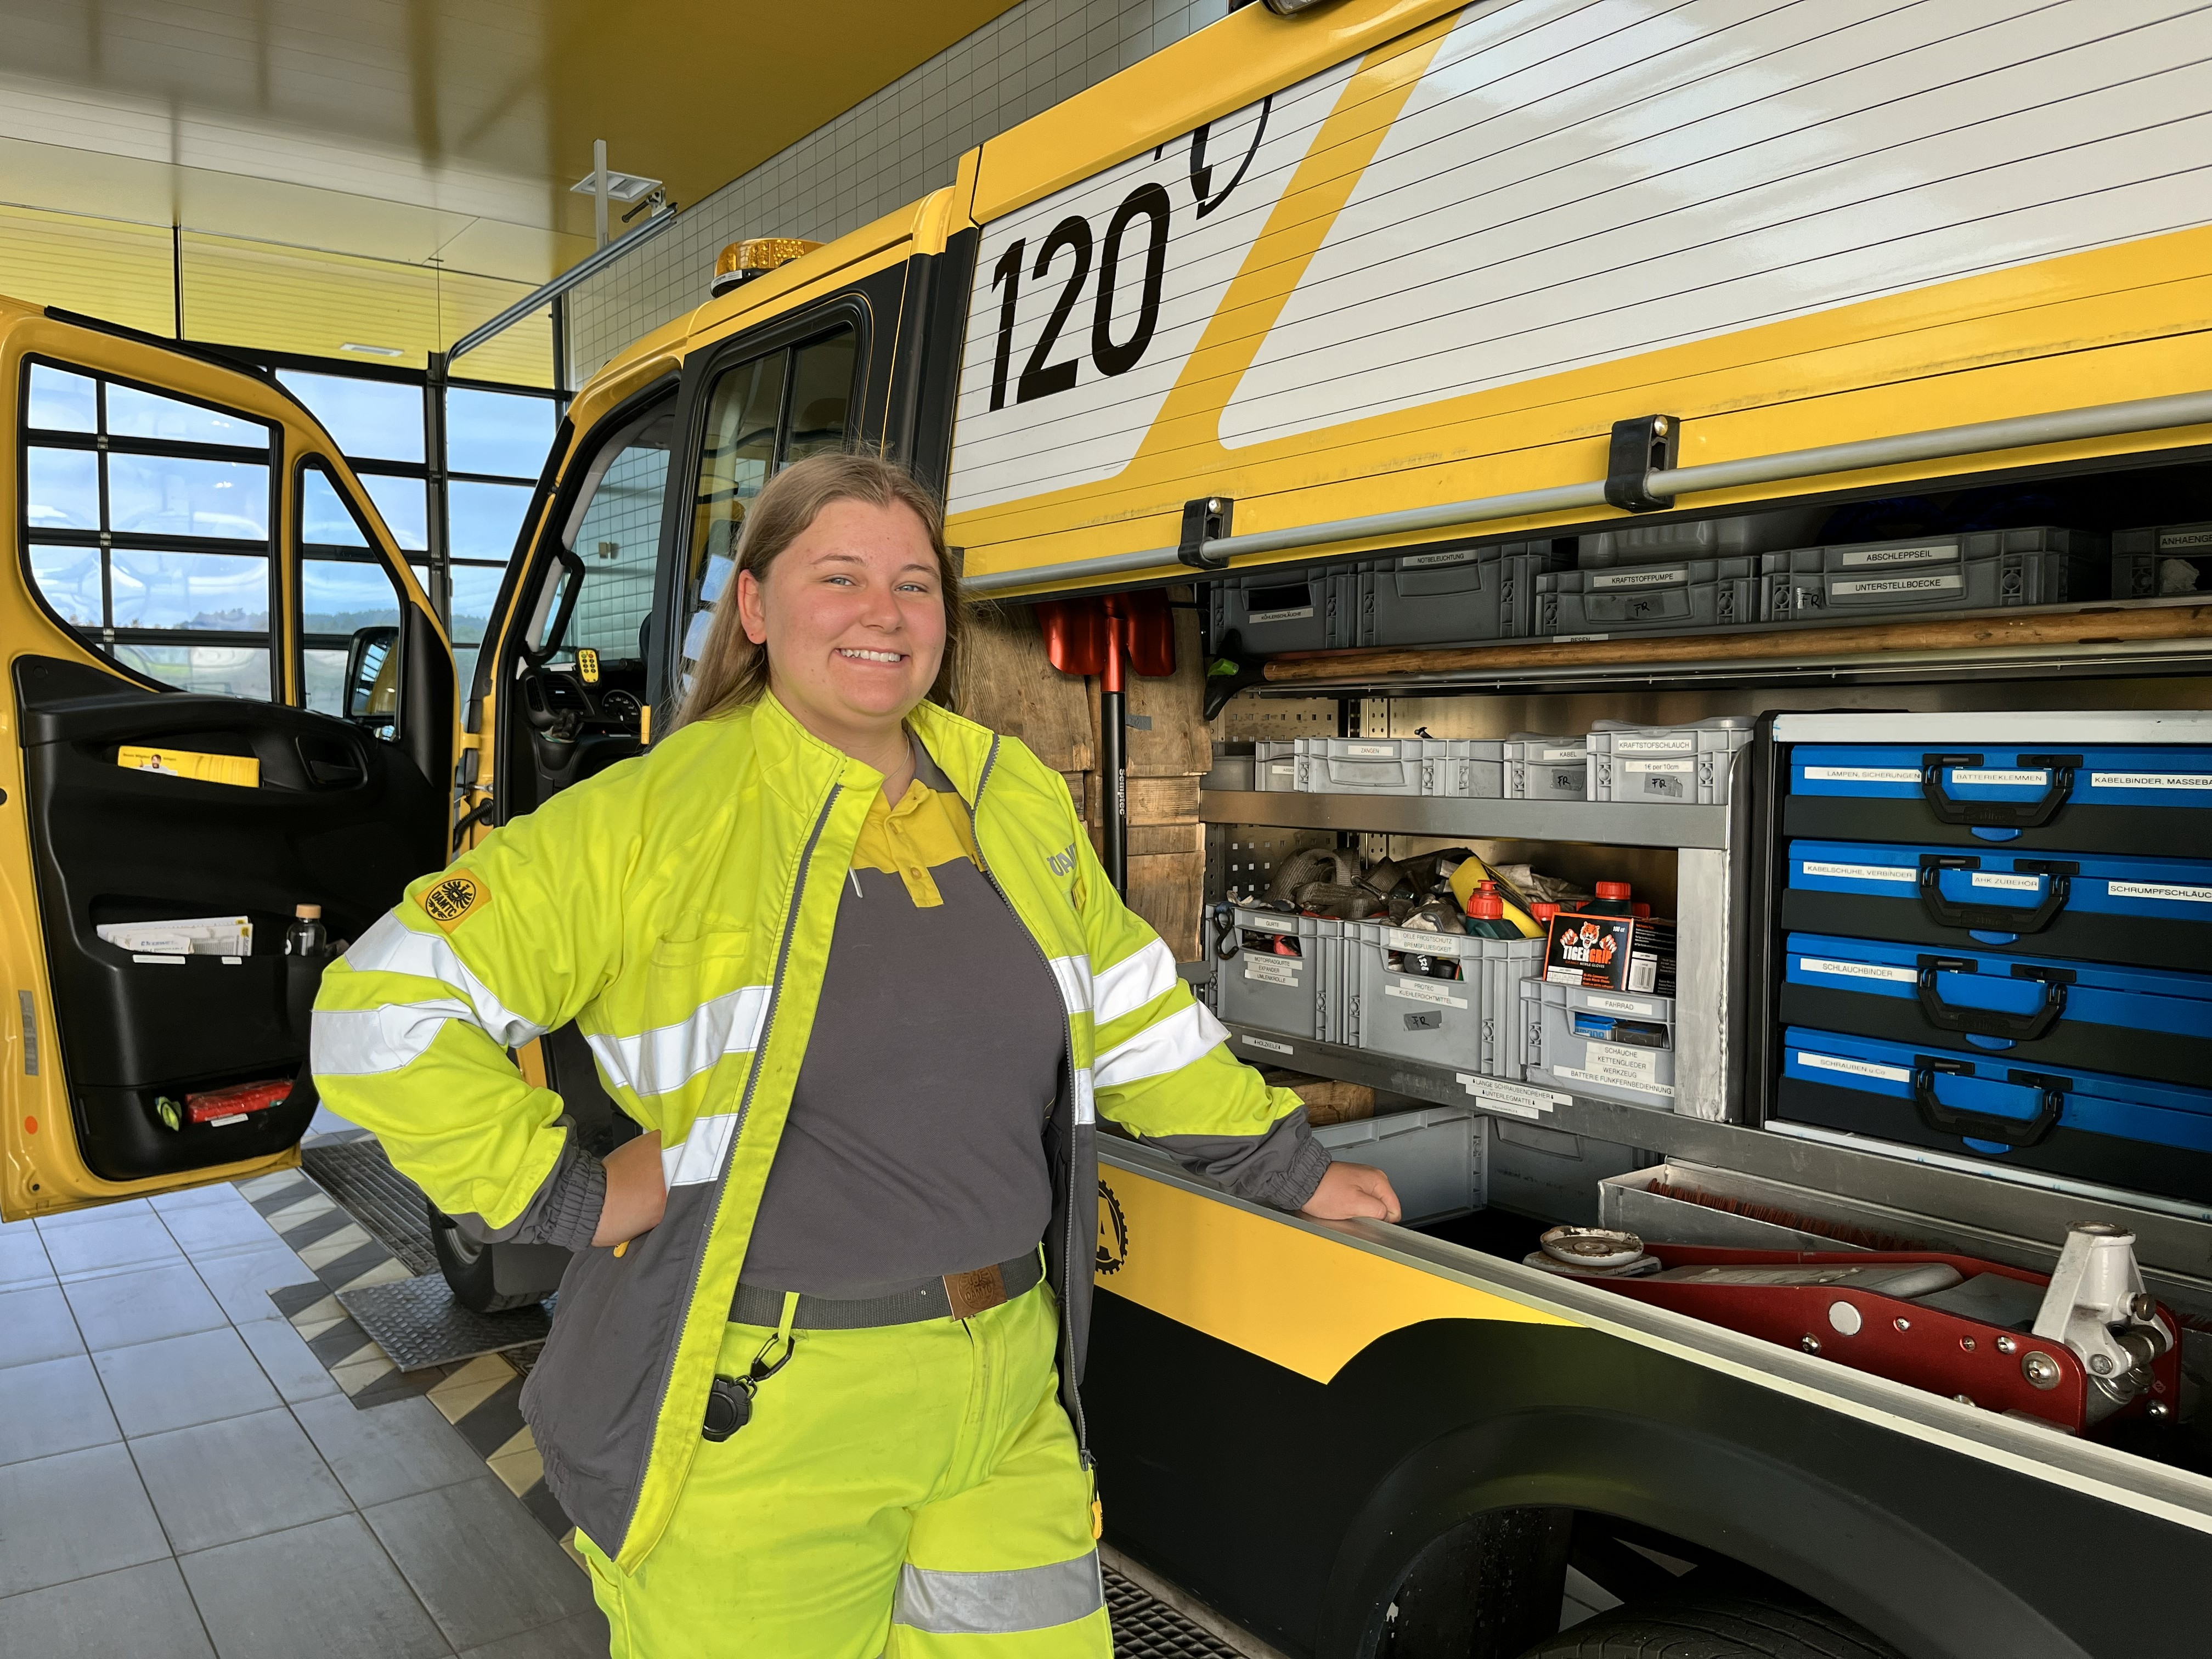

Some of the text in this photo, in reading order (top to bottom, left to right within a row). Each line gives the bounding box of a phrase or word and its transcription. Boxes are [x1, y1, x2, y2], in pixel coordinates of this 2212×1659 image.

[989, 183, 1170, 412] 120
[1417, 554, 1464, 563] NOTBELEUCHTUNG
[1866, 550, 1933, 561] ABSCHLEPPSEIL
[1612, 573, 1674, 584] KRAFTSTOFFPUMPE
[1855, 579, 1941, 591] UNTERSTELLBOECKE
[1801, 592, 1820, 608] FR
[1558, 776, 1571, 787] FR
[1651, 778, 1667, 788] FR
[2095, 777, 2164, 785] KABELBINDER,
[1118, 769, 1126, 816] semptec
[1417, 934, 1452, 944] FROSTSCHUTZ
[1254, 956, 1290, 967] MOTORRADGURTE
[1822, 963, 1893, 977] SCHLAUCHBINDER
[1257, 973, 1286, 983] UMLENKROLLE
[1414, 983, 1434, 991] PROTEC
[1399, 990, 1452, 1005] KUEHLERDICHTMITTEL
[1605, 1001, 1634, 1011] FAHRRAD
[1412, 1016, 1430, 1028] FR
[1598, 1056, 1646, 1069] KETTENGLIEDER
[1820, 1059, 1867, 1072] SCHRAUBEN
[1603, 1066, 1637, 1078] WERKZEUG
[1571, 1070, 1672, 1094] BATTERIE FUNKFERNBEDIEHNUNG
[1476, 1079, 1550, 1099] LANGE SCHRAUBENDREHER
[1486, 1091, 1531, 1105] UNTERLEGMATTE
